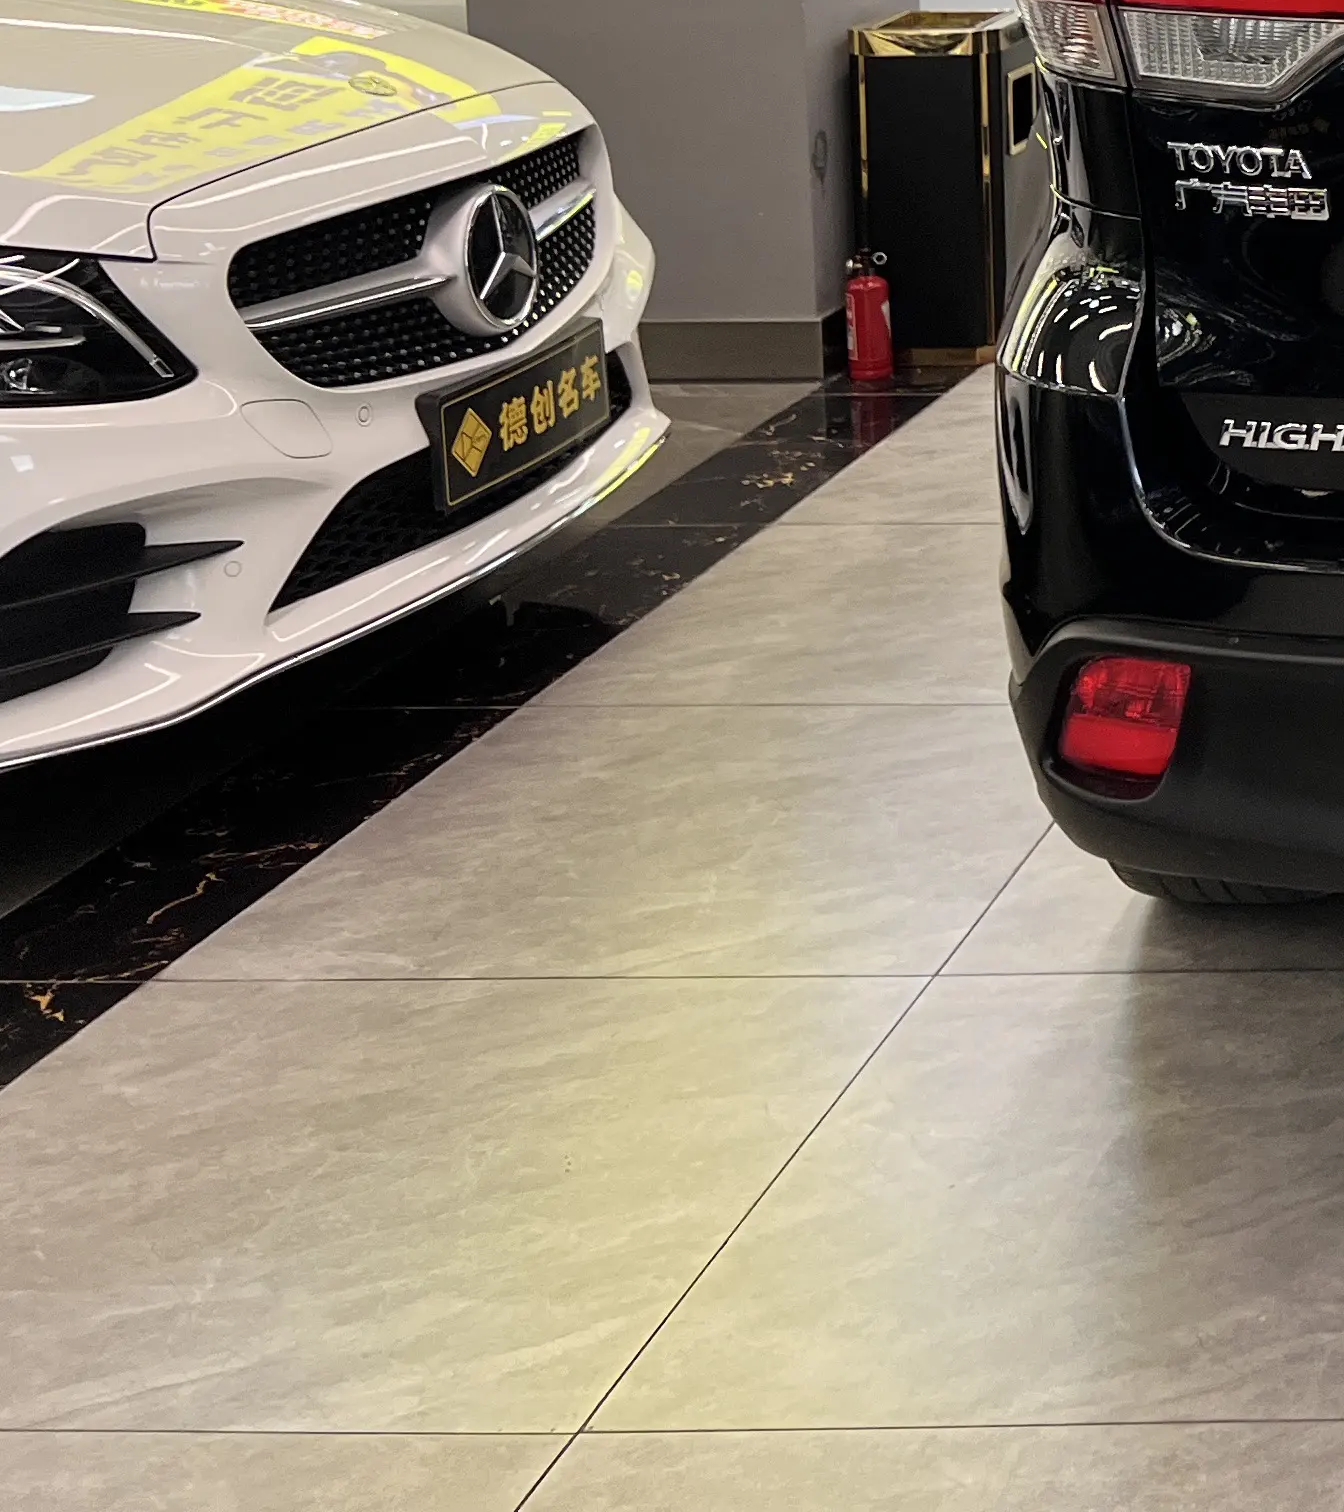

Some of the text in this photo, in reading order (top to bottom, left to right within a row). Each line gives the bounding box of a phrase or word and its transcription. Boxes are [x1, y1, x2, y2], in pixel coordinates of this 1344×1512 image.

[1167, 141, 1312, 180] TOYOTA
[499, 354, 601, 452] 德创名车
